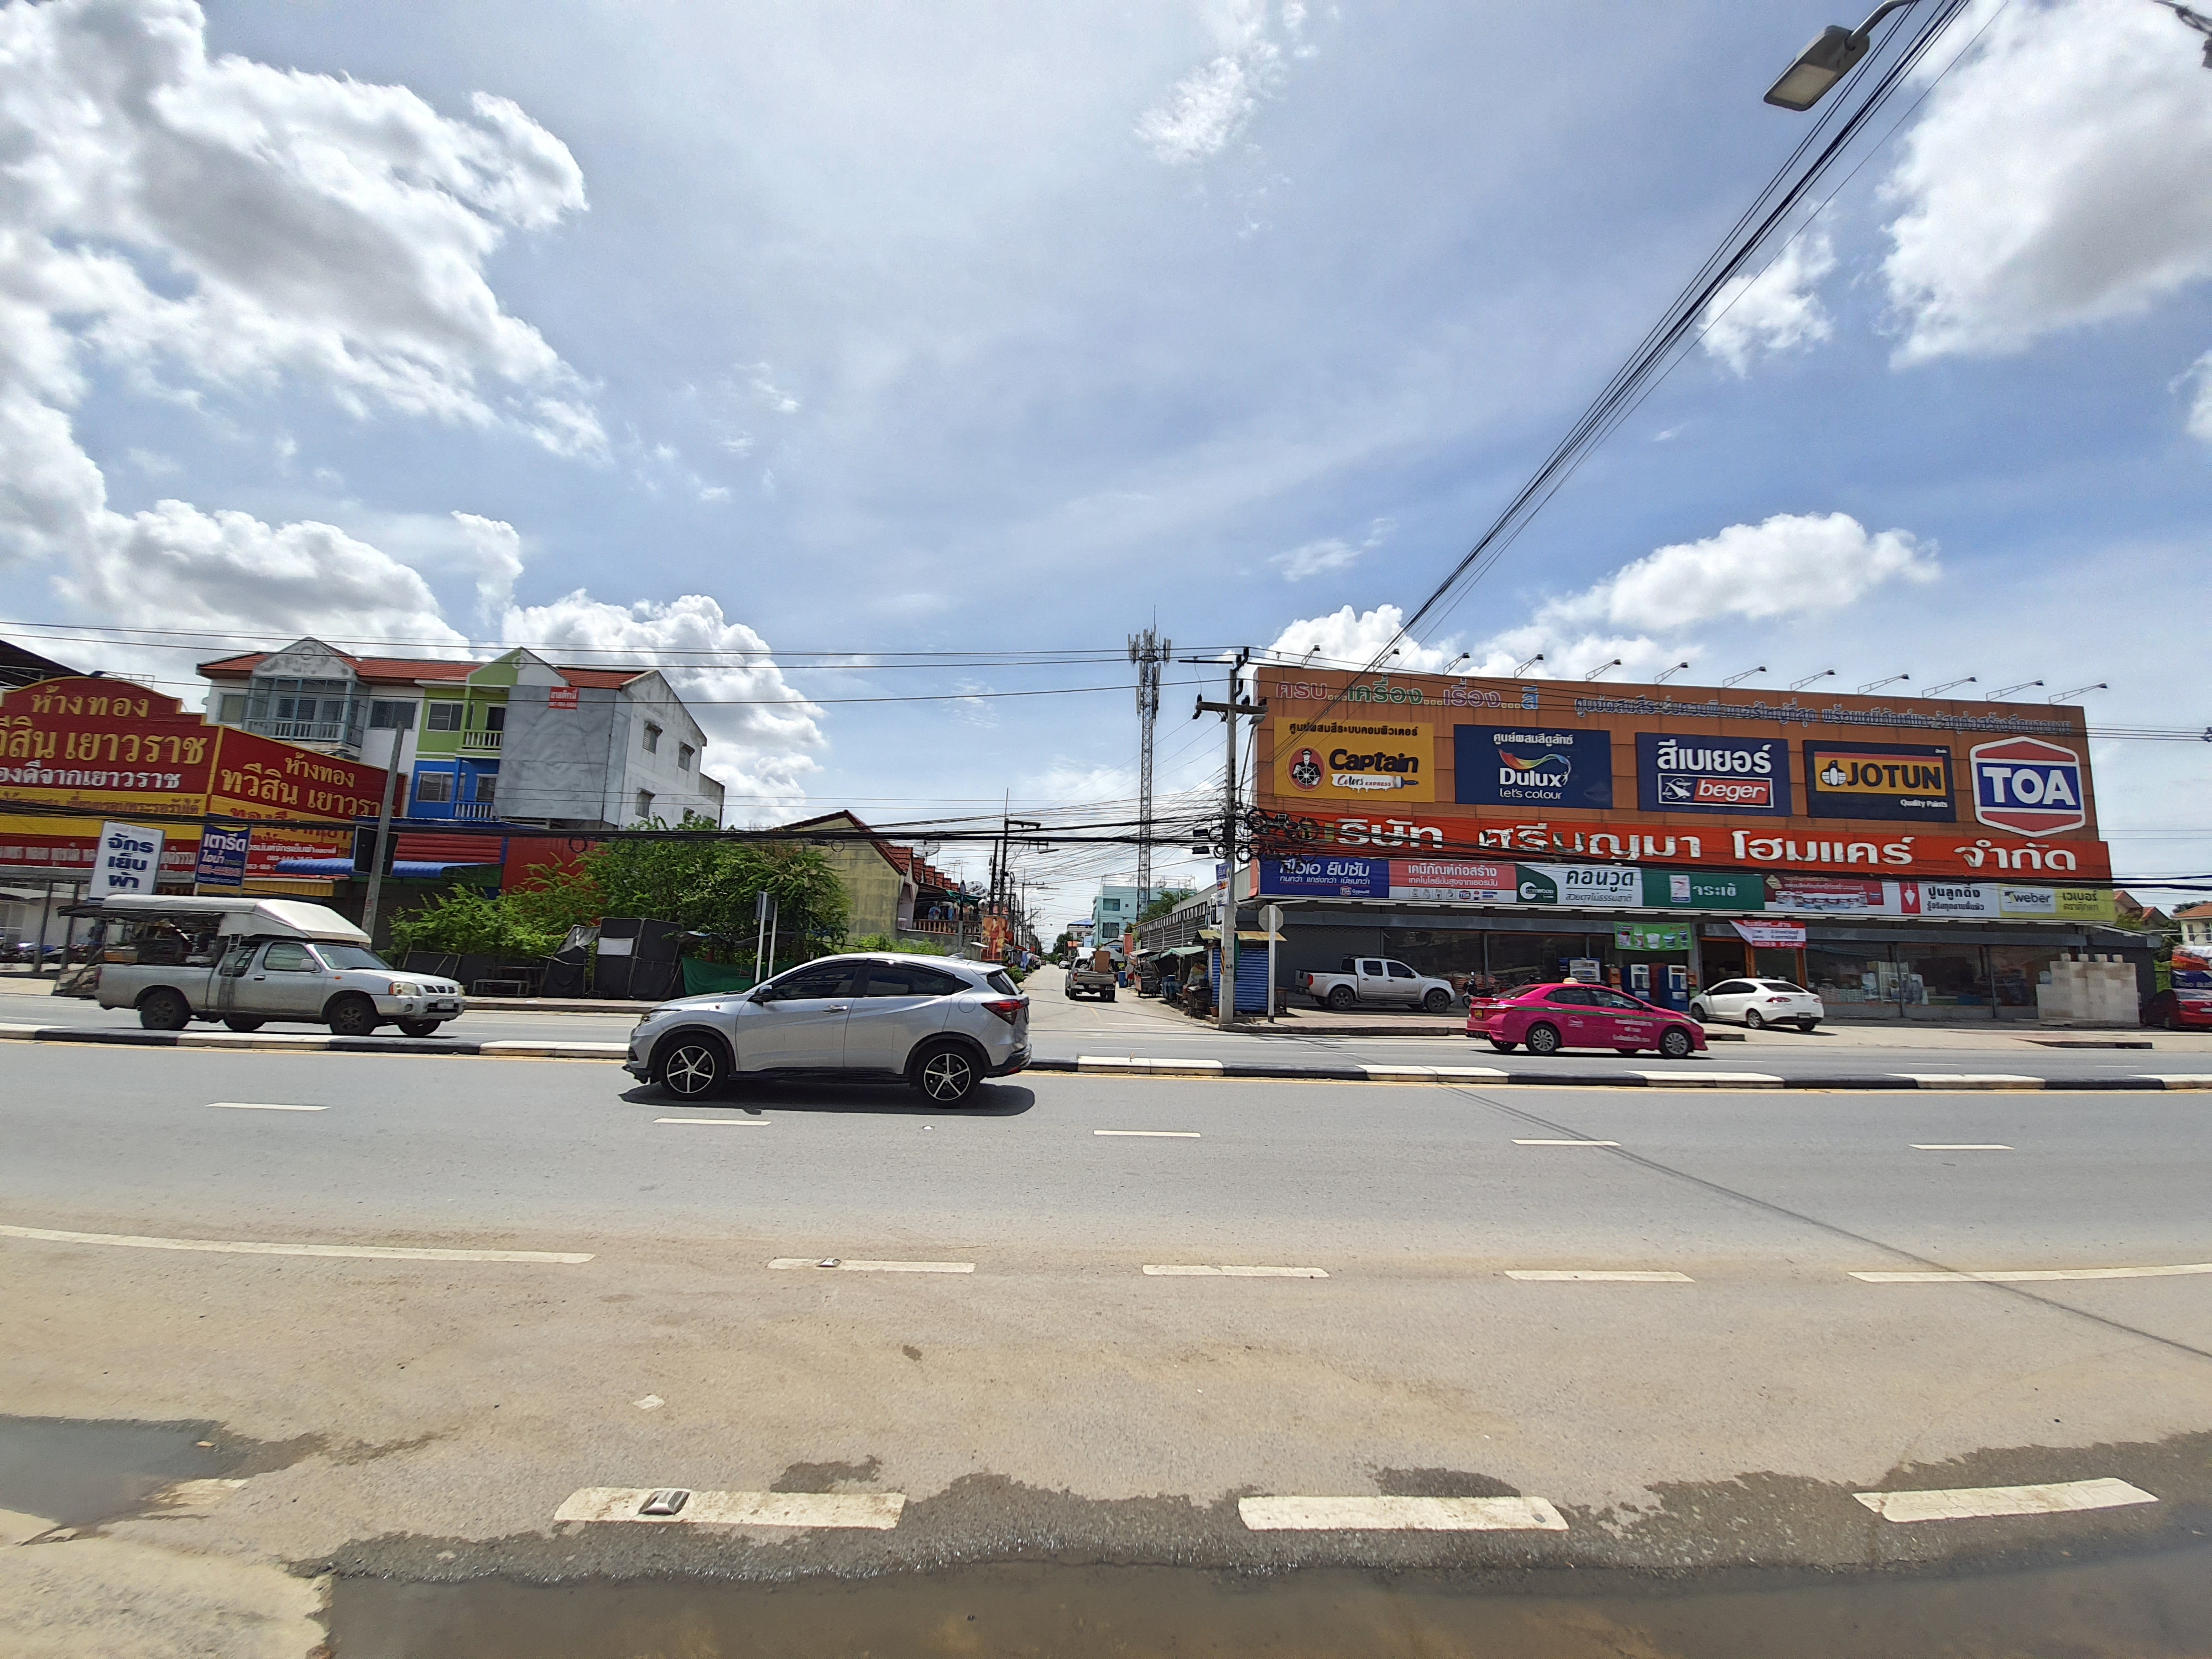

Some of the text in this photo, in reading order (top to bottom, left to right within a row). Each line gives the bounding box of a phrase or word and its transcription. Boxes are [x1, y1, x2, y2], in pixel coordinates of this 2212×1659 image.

[31, 685, 149, 717] ห้างทอง
[65, 732, 208, 764] เยาวราช
[1493, 732, 1574, 747] ศูนย์ผสมสีดูลักซ์
[1329, 748, 1419, 773] Captain
[1657, 739, 1772, 774] สีเบเยอร์
[285, 752, 354, 787] ห้างทอง
[1499, 768, 1564, 787] Dulux
[1847, 761, 1943, 789] JOTUN
[221, 763, 299, 805] ทวีสิน
[307, 790, 396, 817] เยาวรา
[1337, 774, 1363, 787] Colors
[1699, 779, 1766, 801] beger
[1983, 766, 2077, 806] TOA
[1499, 787, 1562, 800] let's colour
[107, 833, 155, 853] จักร
[203, 833, 248, 853] เตารีด
[1479, 823, 1702, 861] ศรีบญมา
[1731, 830, 1914, 865] โฮมแคร์
[1953, 839, 2077, 871] จำกัด
[107, 853, 148, 872] เย็บ
[1327, 862, 1370, 877] ยิปซัม
[1408, 863, 1498, 877] เคมีภัณฑ์ก่อสร้าง
[108, 871, 140, 889] ผ้า
[1306, 875, 1337, 884] แกร่งกว่า
[1340, 877, 1370, 885] เนียนกว่า
[1408, 876, 1498, 887] เทคโนโลยีขั้นสูงจากเยอรมัน
[1566, 870, 1634, 892] คอนวูด
[1692, 882, 1736, 896] จระเข้
[1566, 893, 1632, 902] สวยดุจไม้ธรรมชาติ
[1927, 884, 1981, 900] ปูนลูกดิ่ง
[2013, 892, 2052, 903] weber
[2062, 890, 2098, 901] เวเบอร์
